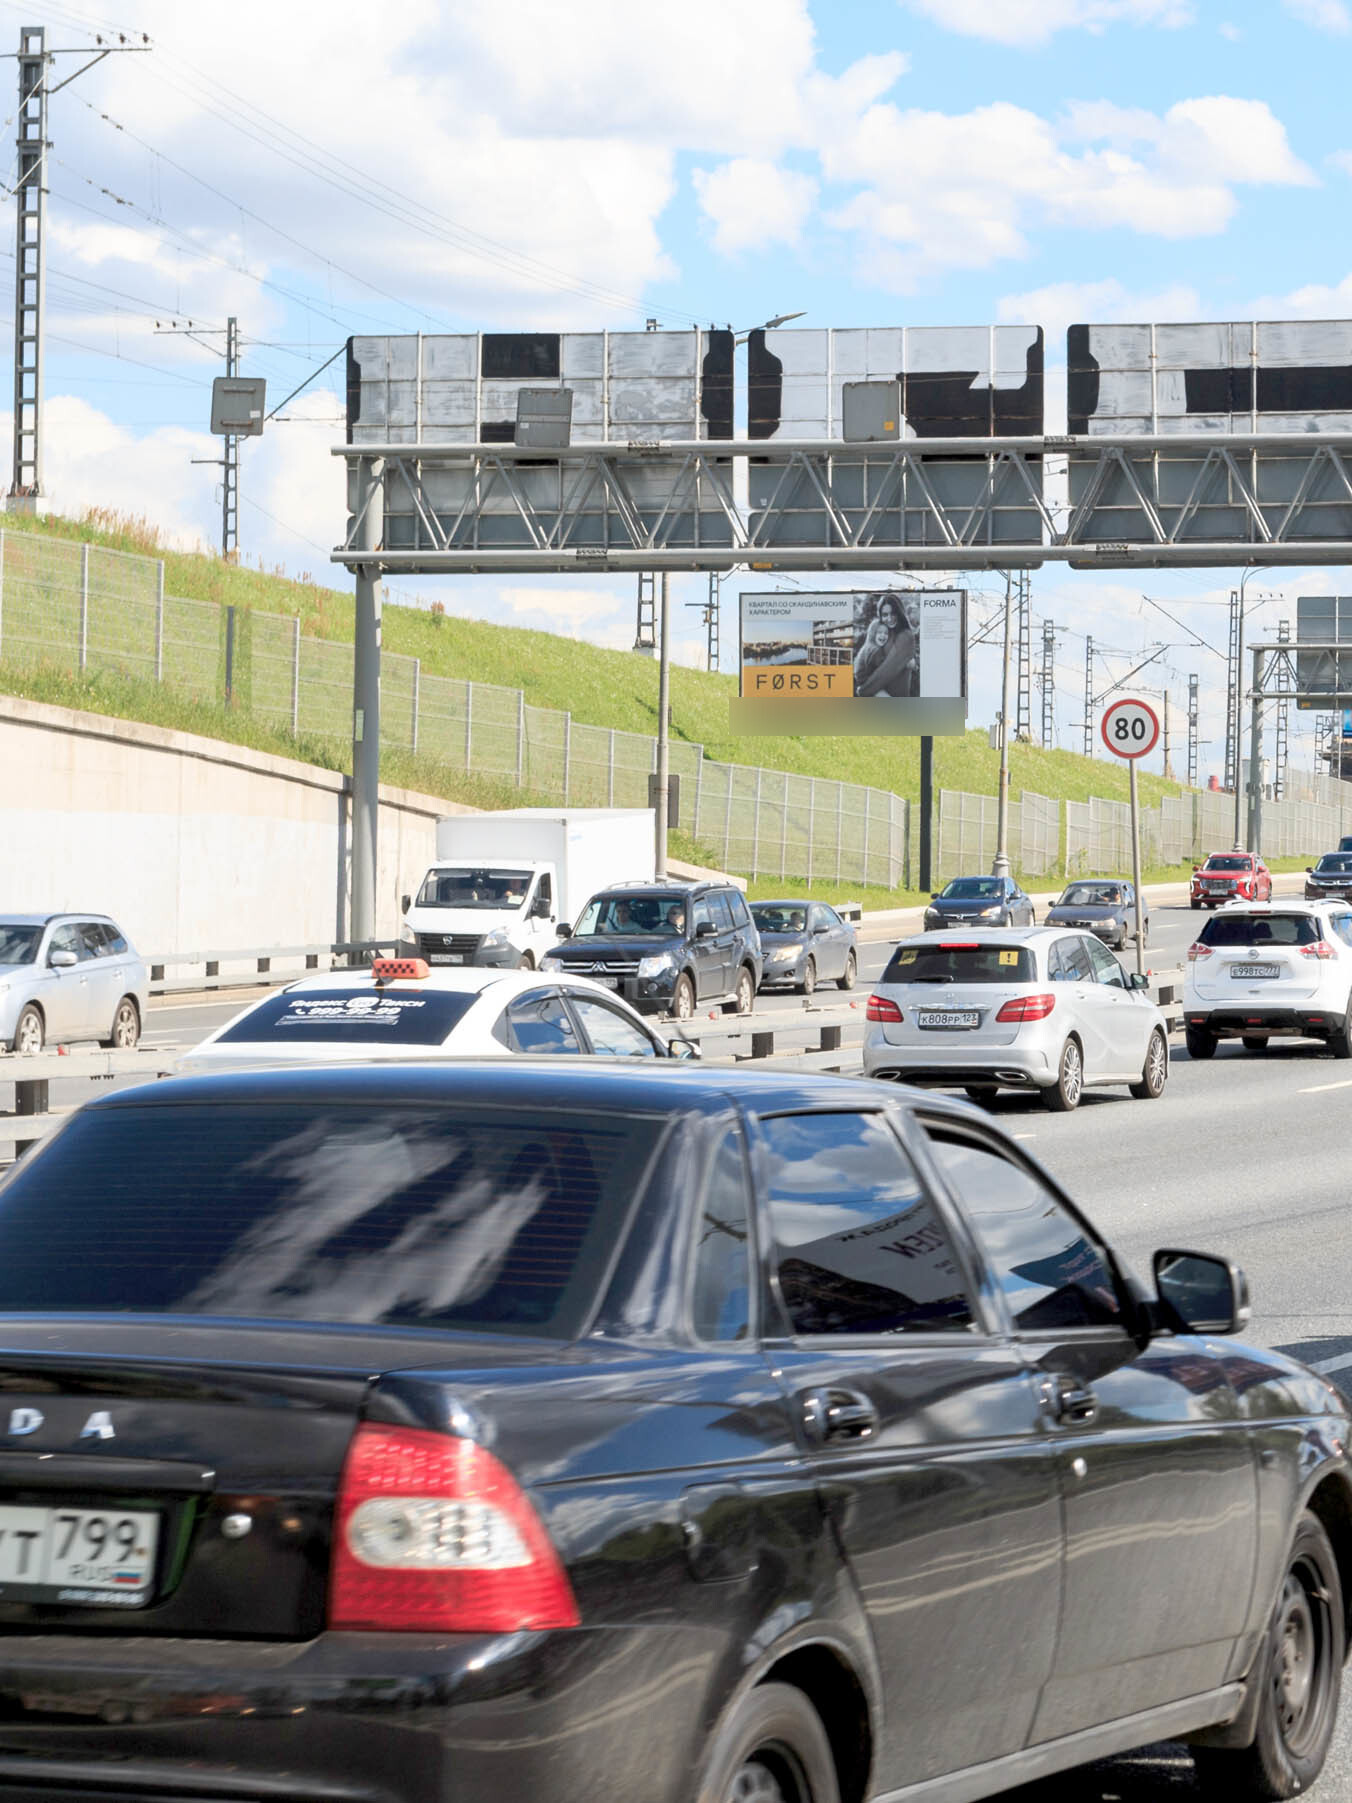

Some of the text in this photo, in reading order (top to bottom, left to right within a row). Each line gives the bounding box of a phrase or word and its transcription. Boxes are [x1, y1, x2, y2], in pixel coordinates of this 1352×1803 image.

[923, 599, 957, 608] FORMA
[755, 673, 837, 691] FØRST
[1115, 717, 1146, 741] 80
[55, 1515, 140, 1562] 799
